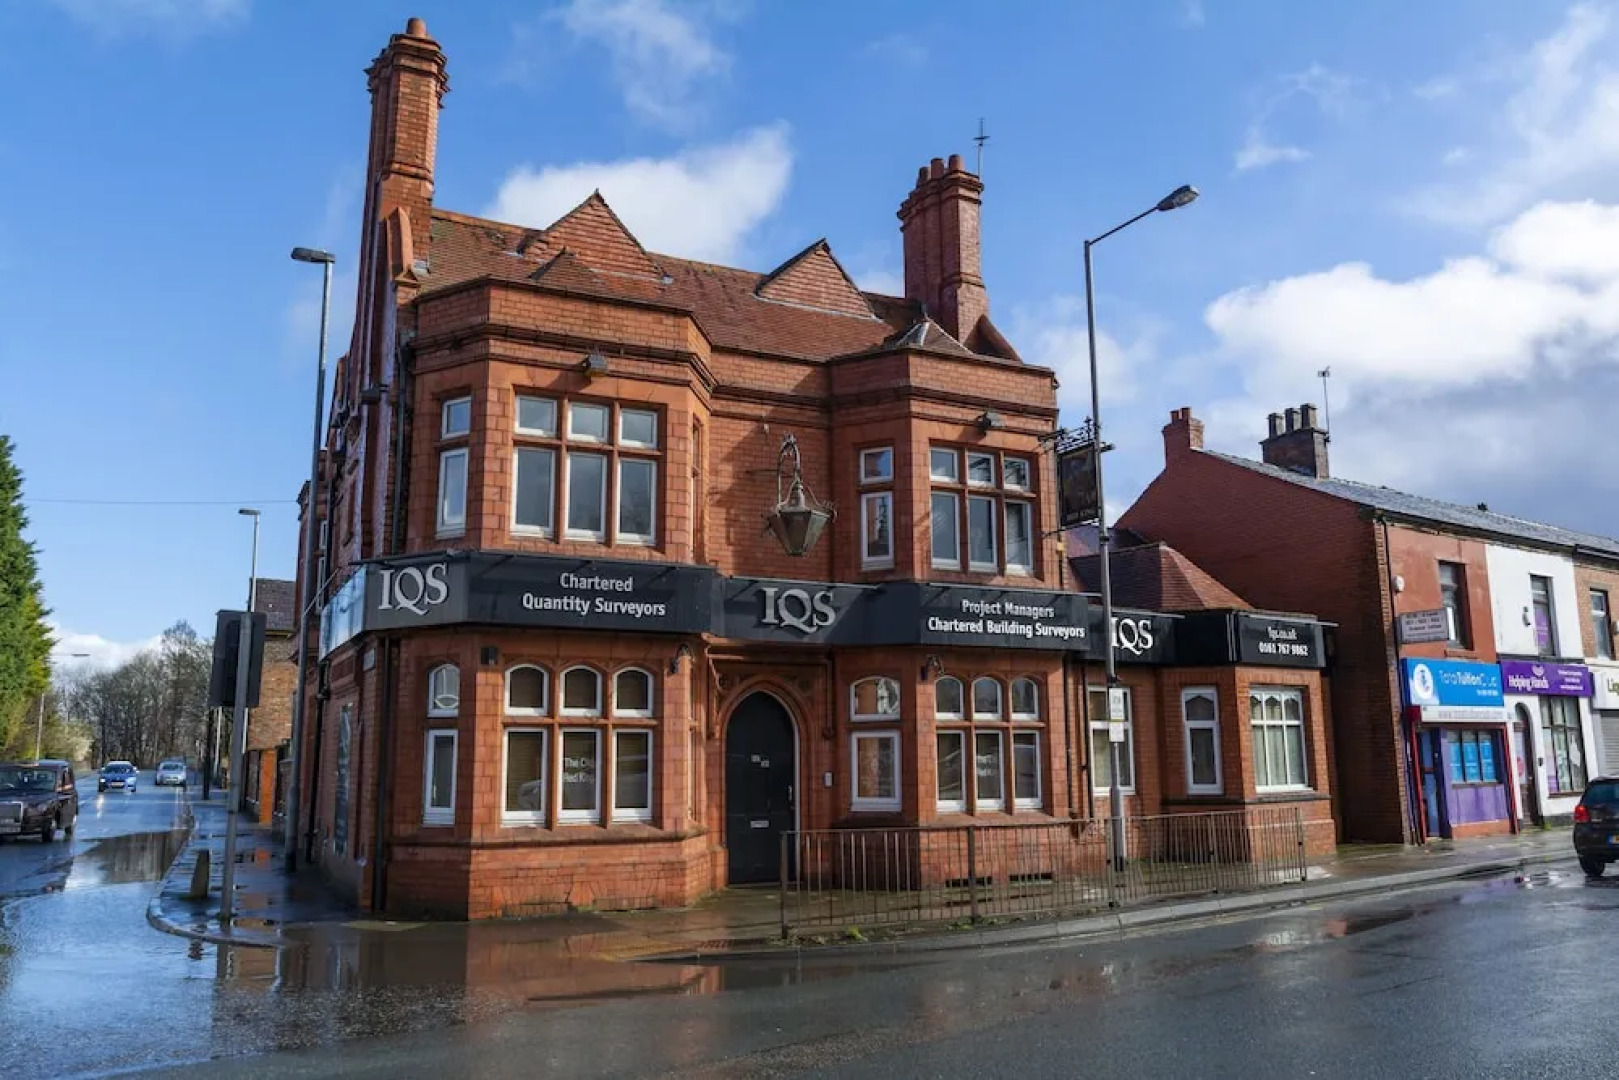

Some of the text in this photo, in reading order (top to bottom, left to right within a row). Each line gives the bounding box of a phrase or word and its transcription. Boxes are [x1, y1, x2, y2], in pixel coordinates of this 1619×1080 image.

[378, 562, 449, 616] IQS
[560, 572, 634, 592] Chartered
[522, 593, 666, 618] Quantity Surveyors
[760, 586, 836, 633] IQS
[962, 599, 1055, 619] Project Managers
[928, 616, 1085, 640] Chartered Building Surveyors
